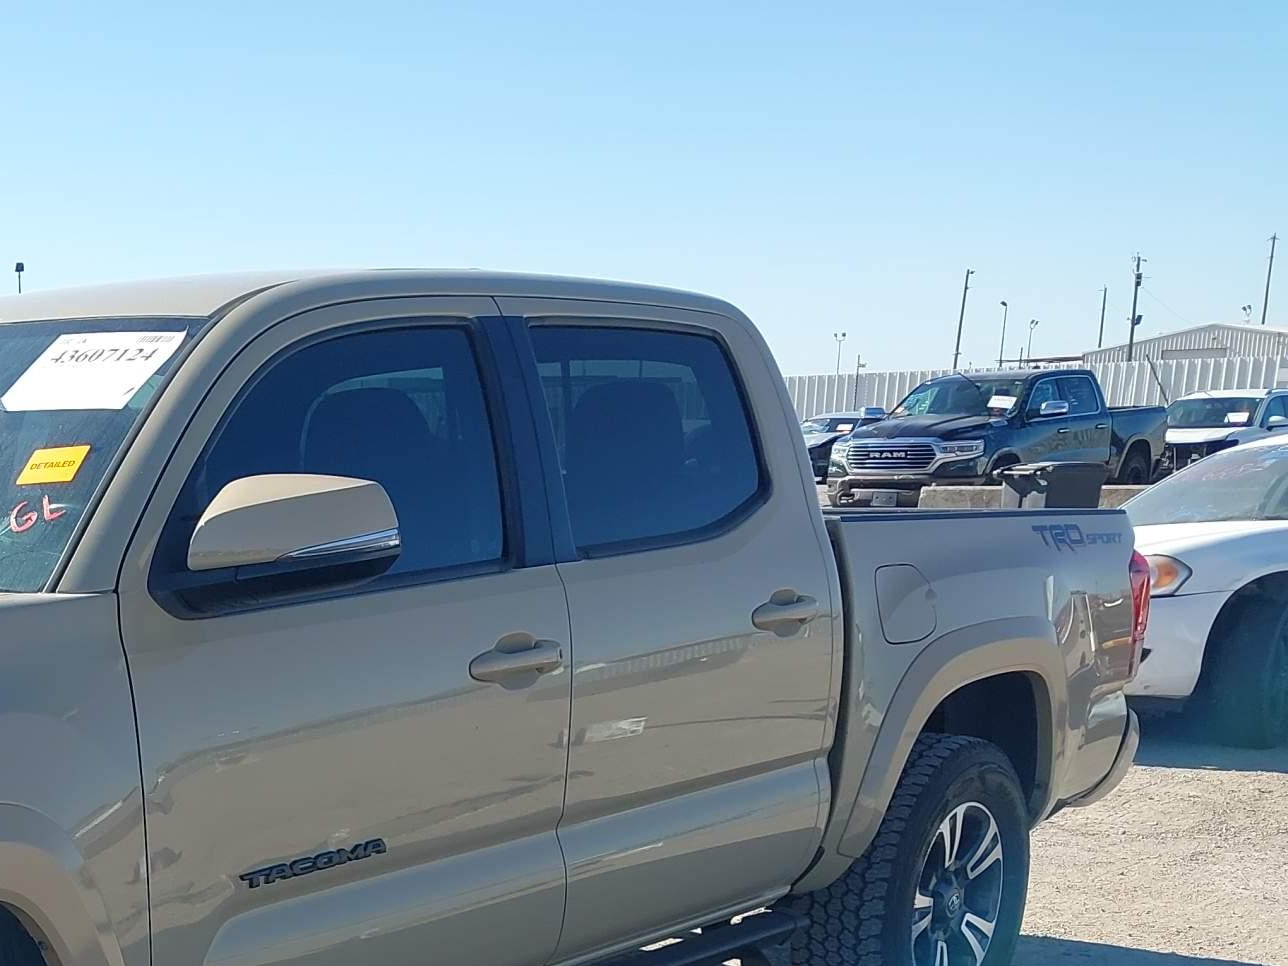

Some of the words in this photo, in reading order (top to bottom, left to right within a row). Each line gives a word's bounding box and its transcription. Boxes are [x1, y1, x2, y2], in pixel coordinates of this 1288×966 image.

[51, 347, 159, 364] 43607124
[30, 460, 75, 470] DETAILED
[1032, 524, 1086, 552] TRD
[1086, 533, 1122, 544] SPORT
[239, 838, 387, 888] TACOMA
